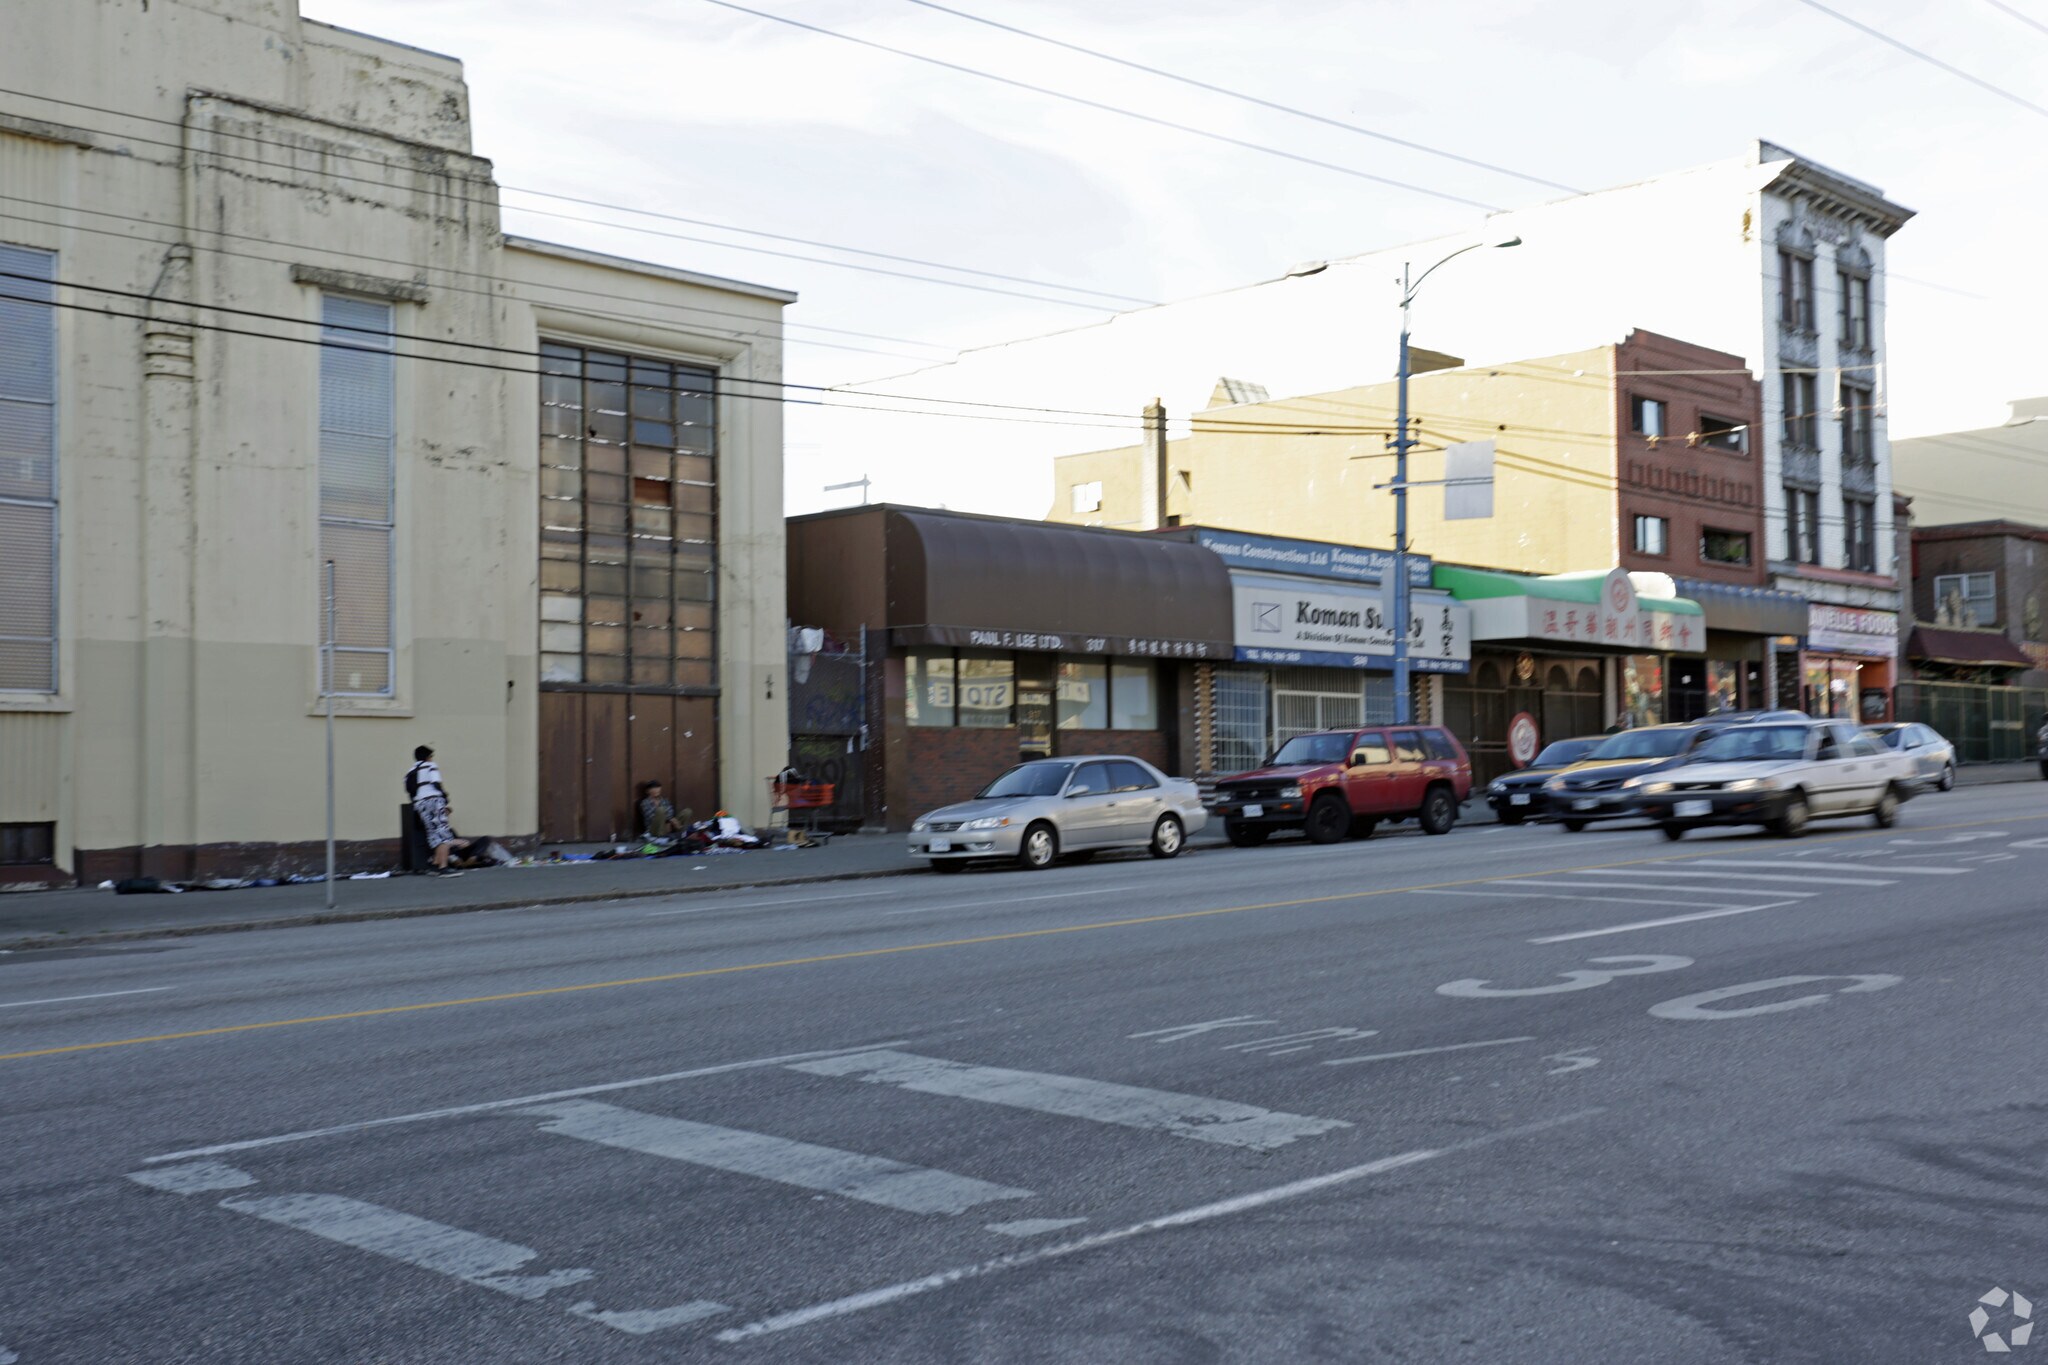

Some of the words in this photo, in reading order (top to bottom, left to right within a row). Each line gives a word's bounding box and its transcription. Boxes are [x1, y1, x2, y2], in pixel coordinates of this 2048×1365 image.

[1295, 601, 1360, 628] Koman
[970, 630, 1001, 646] PAUL
[1015, 633, 1037, 648] LEE
